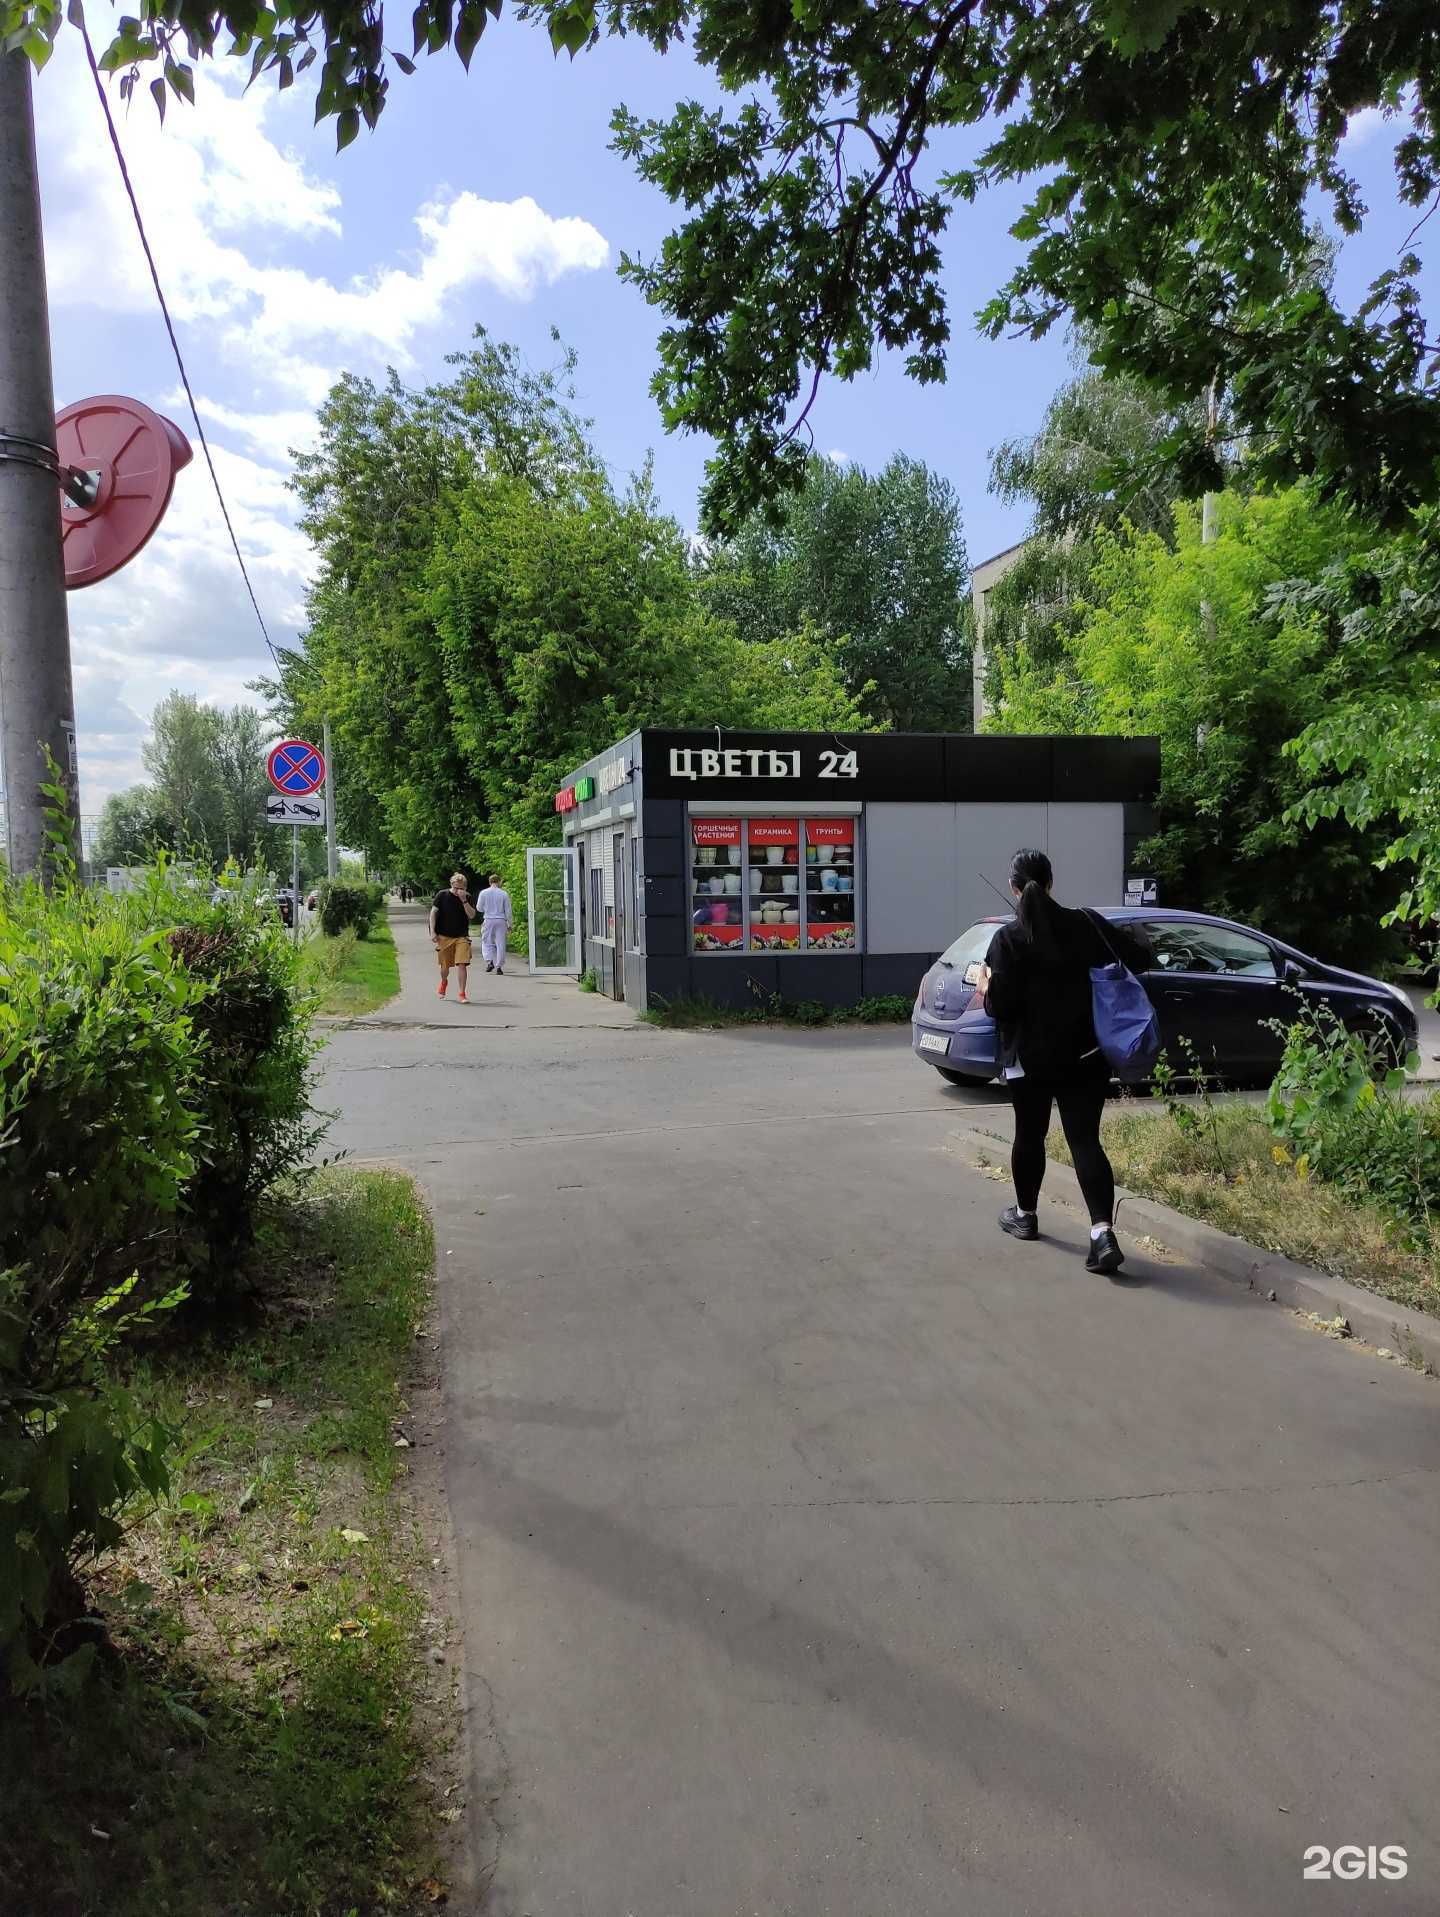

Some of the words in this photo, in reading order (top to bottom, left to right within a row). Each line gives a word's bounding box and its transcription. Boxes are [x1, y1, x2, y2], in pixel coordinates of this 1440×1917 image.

[670, 748, 800, 780] ЦВЕТЫ
[817, 750, 859, 778] 24
[754, 828, 793, 836] КЕРАМИКА
